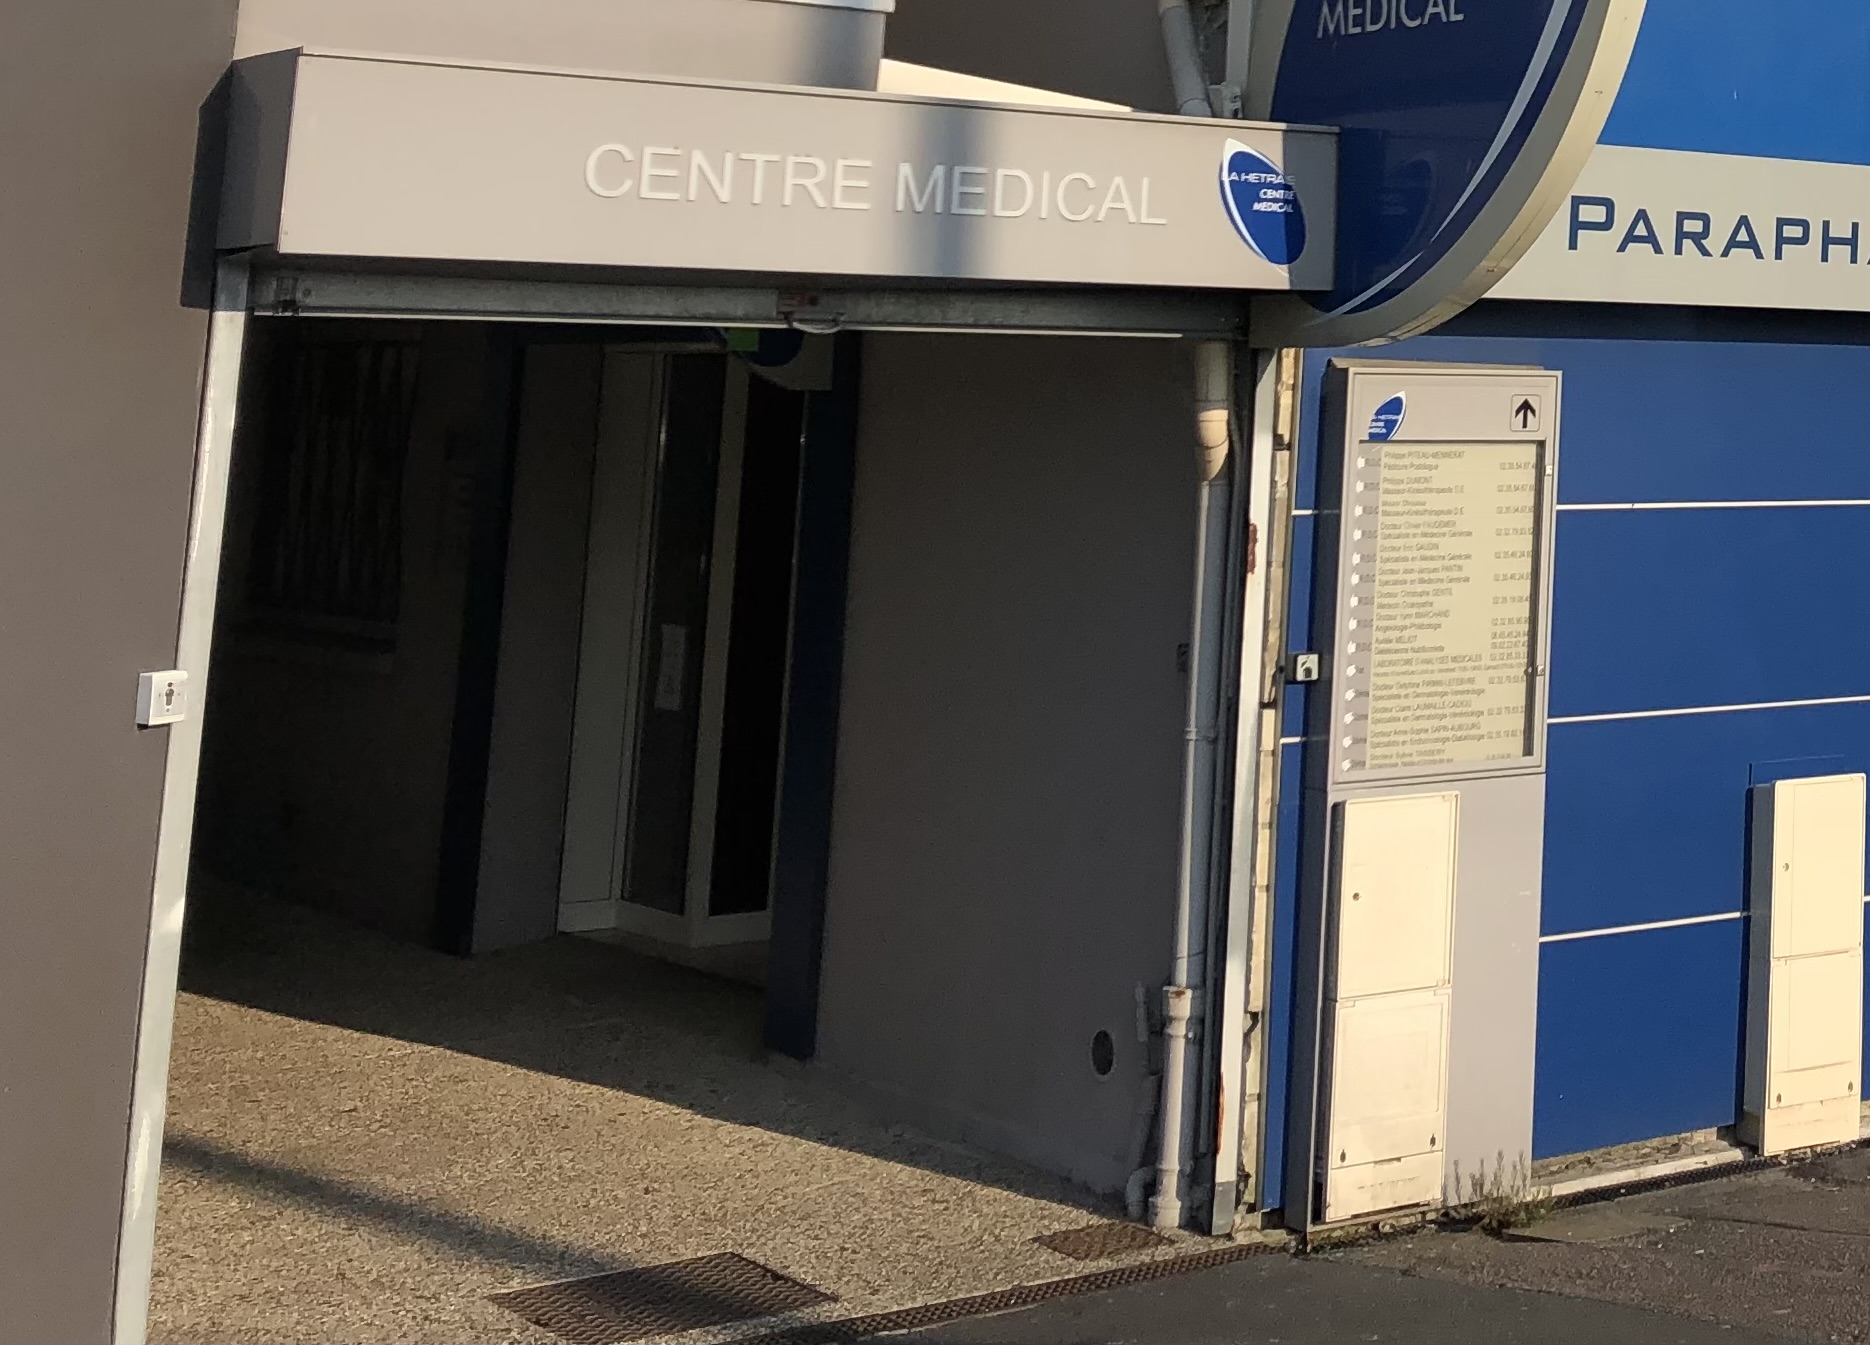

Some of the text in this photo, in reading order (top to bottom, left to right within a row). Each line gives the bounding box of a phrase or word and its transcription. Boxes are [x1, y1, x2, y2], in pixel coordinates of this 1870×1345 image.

[584, 143, 1168, 226] CENTRE MEDICAL
[1251, 202, 1294, 213] MEDICAL
